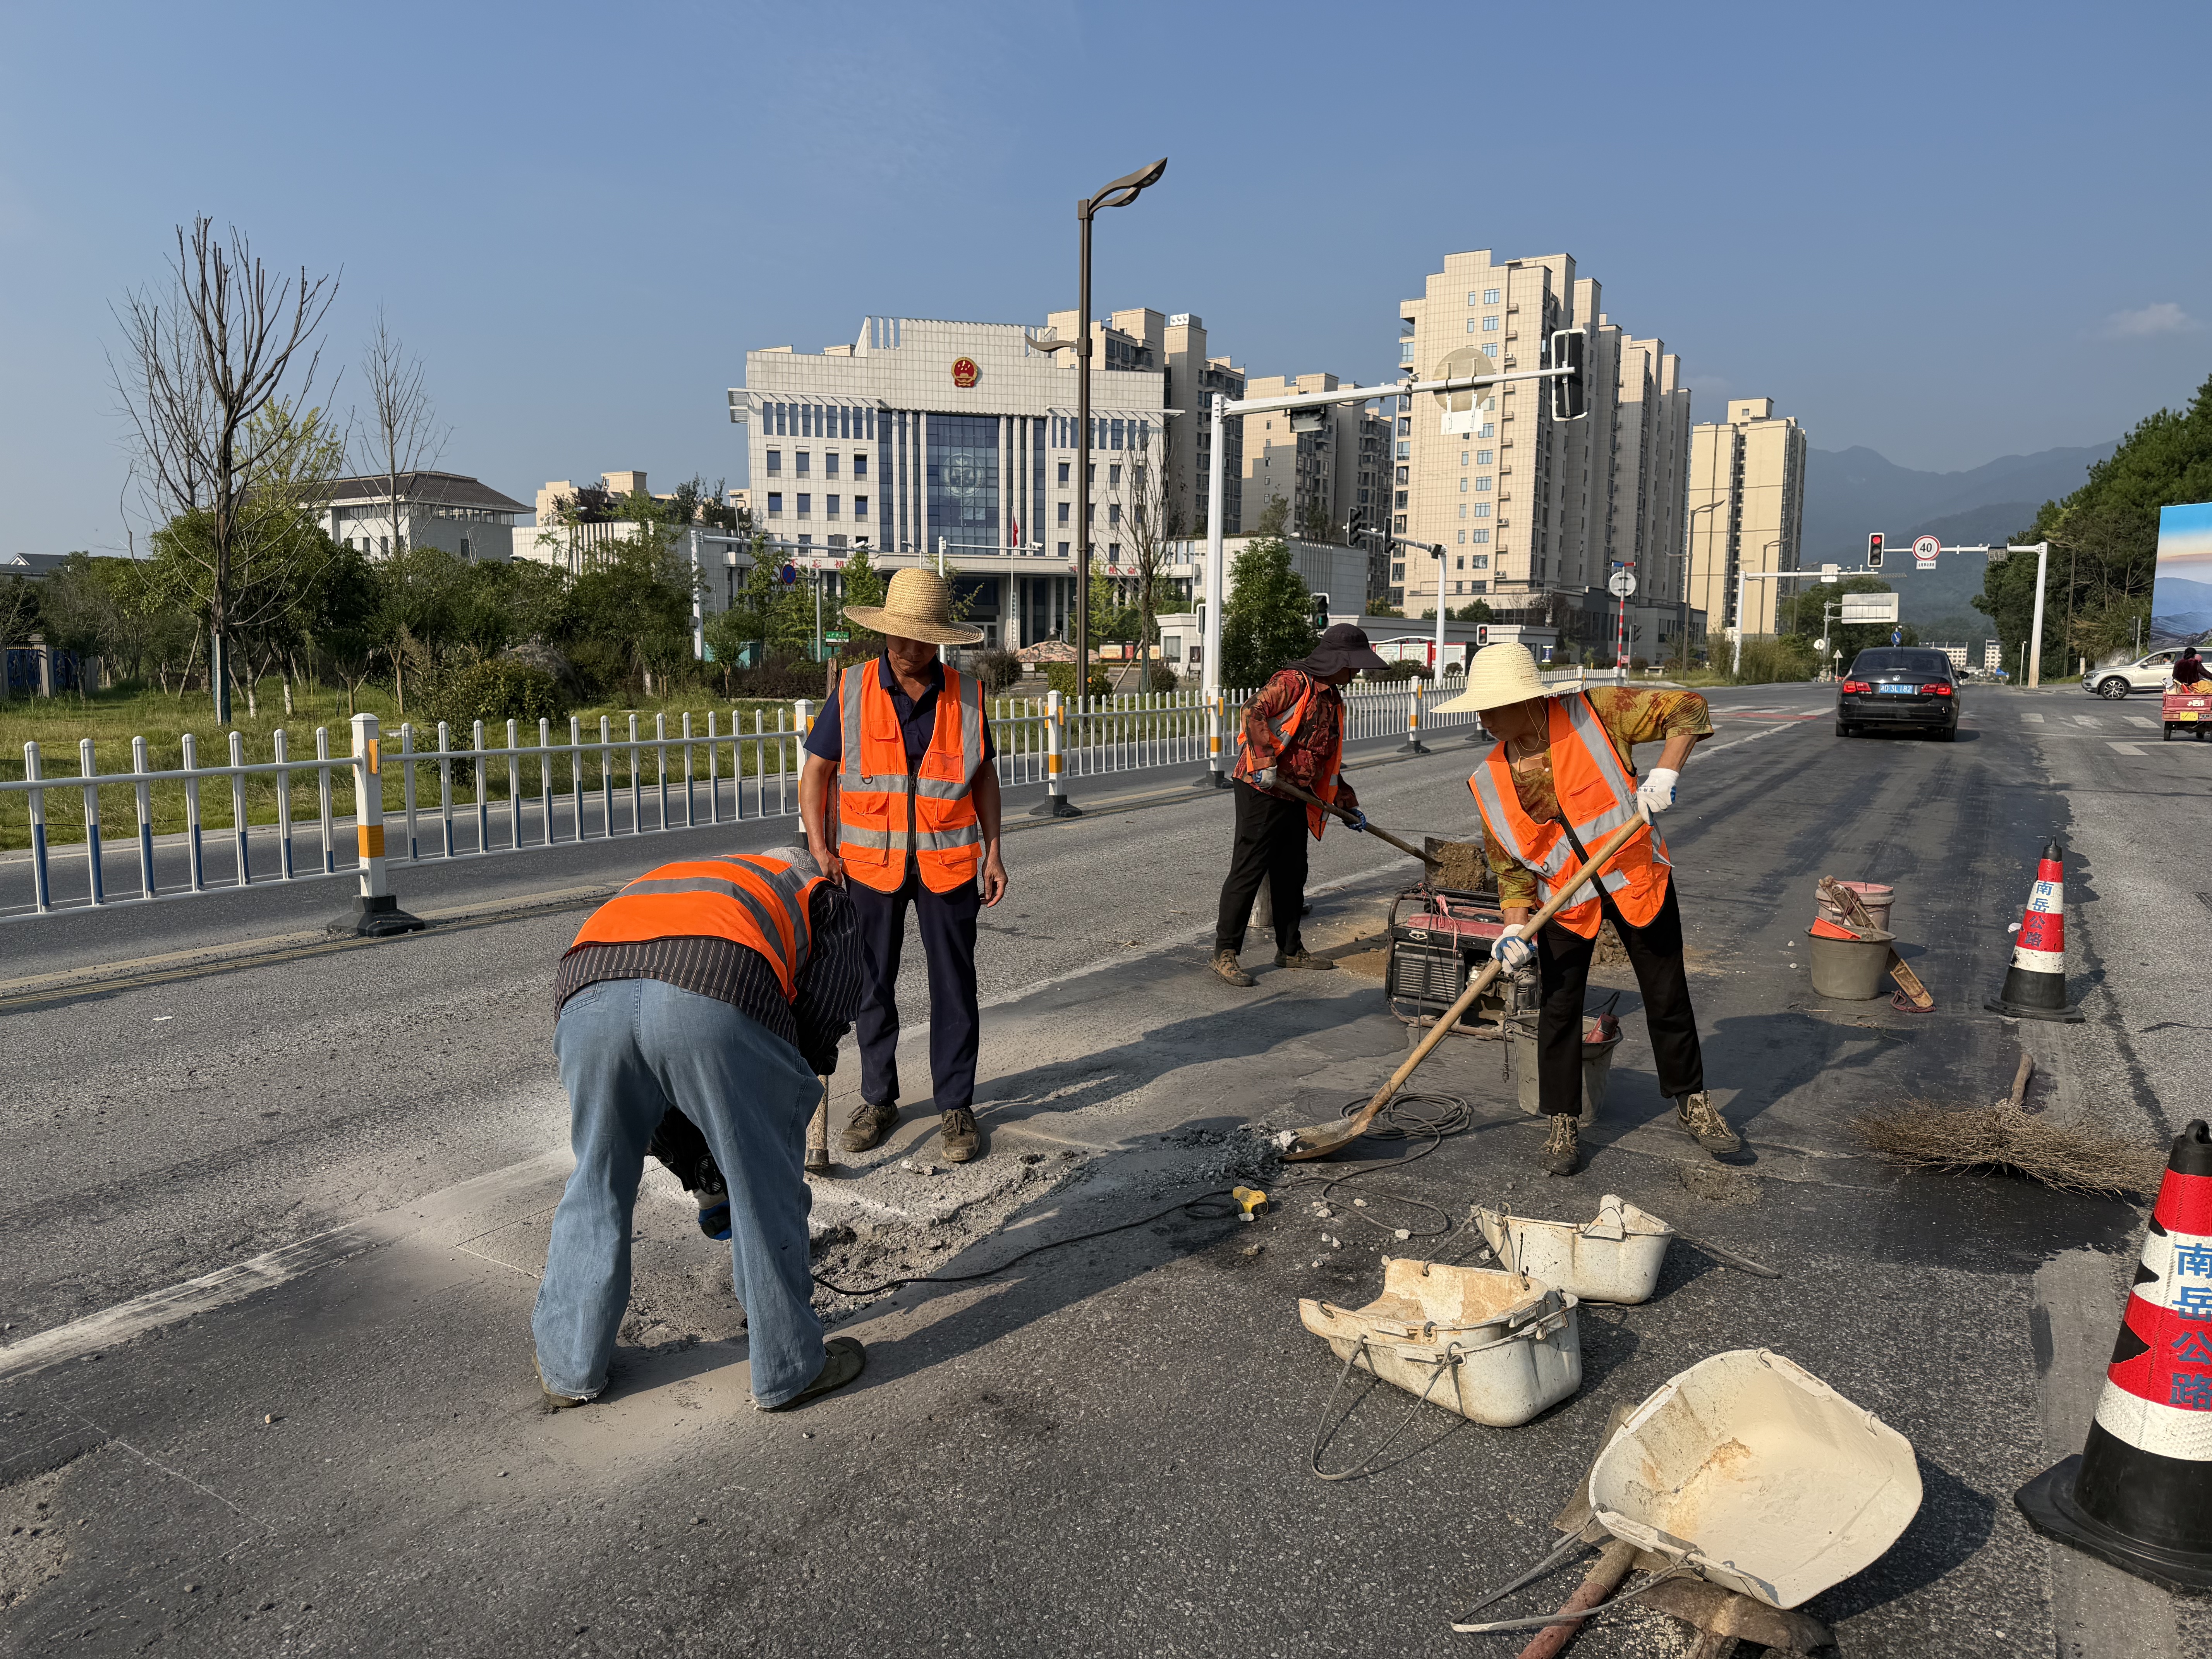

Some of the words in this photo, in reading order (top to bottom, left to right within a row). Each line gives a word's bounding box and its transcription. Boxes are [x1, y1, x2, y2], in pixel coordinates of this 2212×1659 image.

[791, 558, 844, 568] 不忘初
[1920, 543, 1932, 552] 40
[2025, 881, 2054, 947] 南岳公路
[2169, 1243, 2212, 1410] 南岳公路
